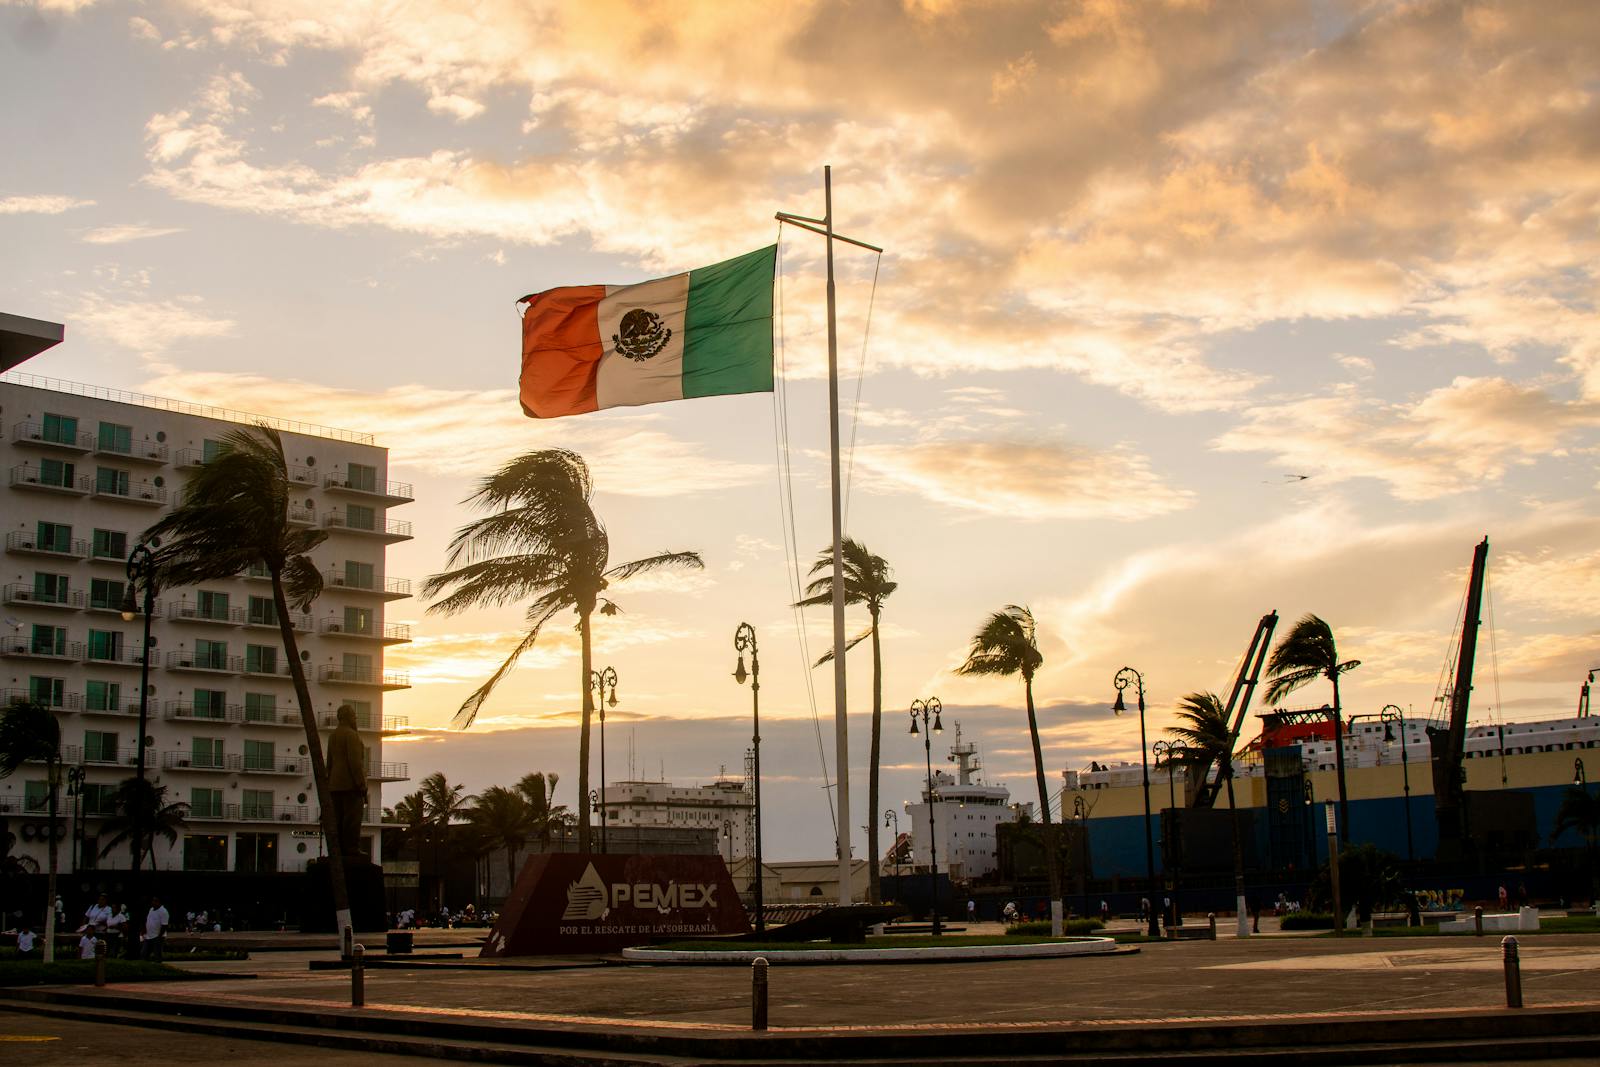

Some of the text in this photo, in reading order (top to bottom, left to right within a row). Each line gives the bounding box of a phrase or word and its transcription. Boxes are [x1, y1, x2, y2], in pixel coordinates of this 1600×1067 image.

[611, 883, 718, 909] PEMEX
[559, 926, 578, 935] POR
[581, 926, 593, 935] EL
[595, 925, 636, 935] RESCATE
[639, 925, 650, 934] DE
